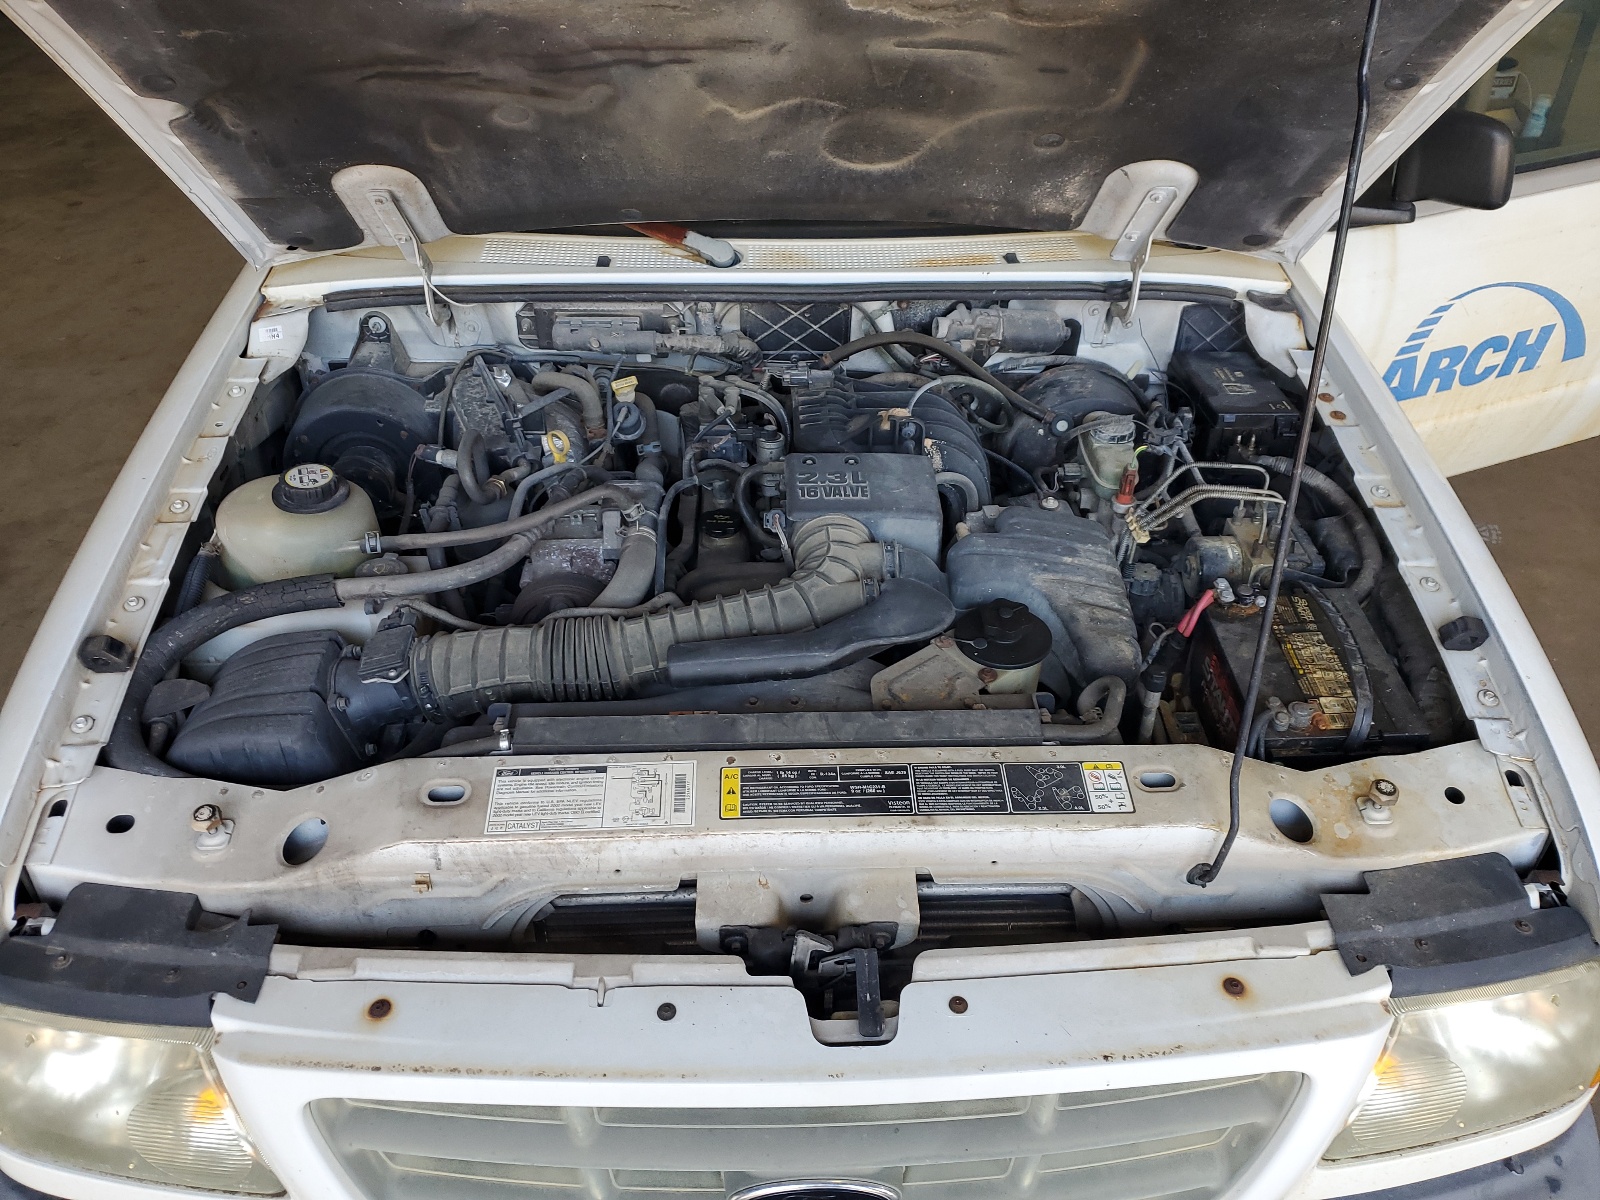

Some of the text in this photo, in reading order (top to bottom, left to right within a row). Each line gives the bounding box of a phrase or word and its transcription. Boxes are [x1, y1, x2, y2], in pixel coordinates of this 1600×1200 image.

[1382, 323, 1557, 402] ARCH
[797, 471, 868, 486] 2.3L
[800, 486, 869, 498] 16 VALVE
[507, 821, 540, 830] CATALYST
